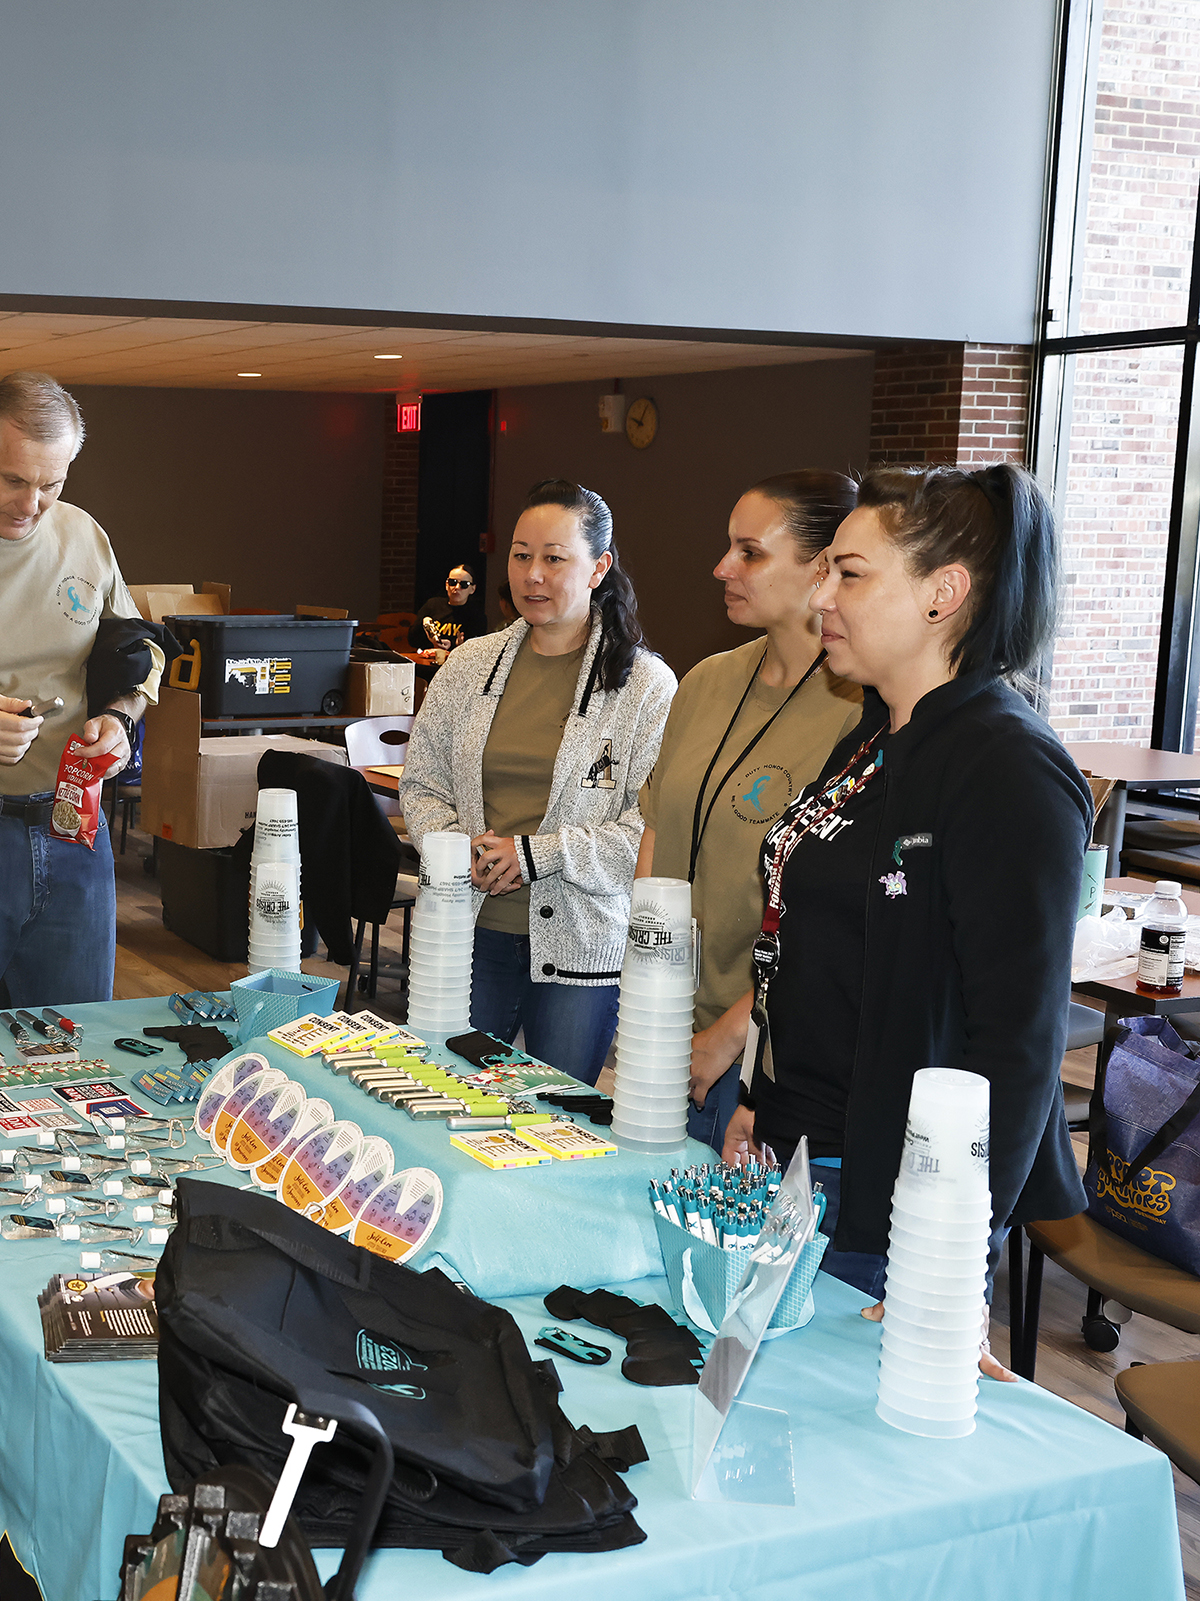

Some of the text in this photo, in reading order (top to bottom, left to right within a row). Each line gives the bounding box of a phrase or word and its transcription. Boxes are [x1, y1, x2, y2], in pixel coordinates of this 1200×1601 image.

[402, 406, 417, 430] EXIT
[434, 620, 462, 636] RMY
[63, 764, 94, 781] POPCORN
[745, 767, 760, 778] DUTY
[783, 770, 793, 797] COUNTRY
[734, 809, 748, 822] GOOD
[749, 811, 780, 825] TEAMMATE
[1090, 887, 1096, 898] P
[653, 932, 673, 946] THE
[308, 1017, 341, 1033] CONSENT
[337, 1015, 367, 1032] CONSENT
[360, 1014, 390, 1031] CONSENT
[498, 1133, 537, 1152] CONSENT
[564, 1125, 606, 1144] CONSENT
